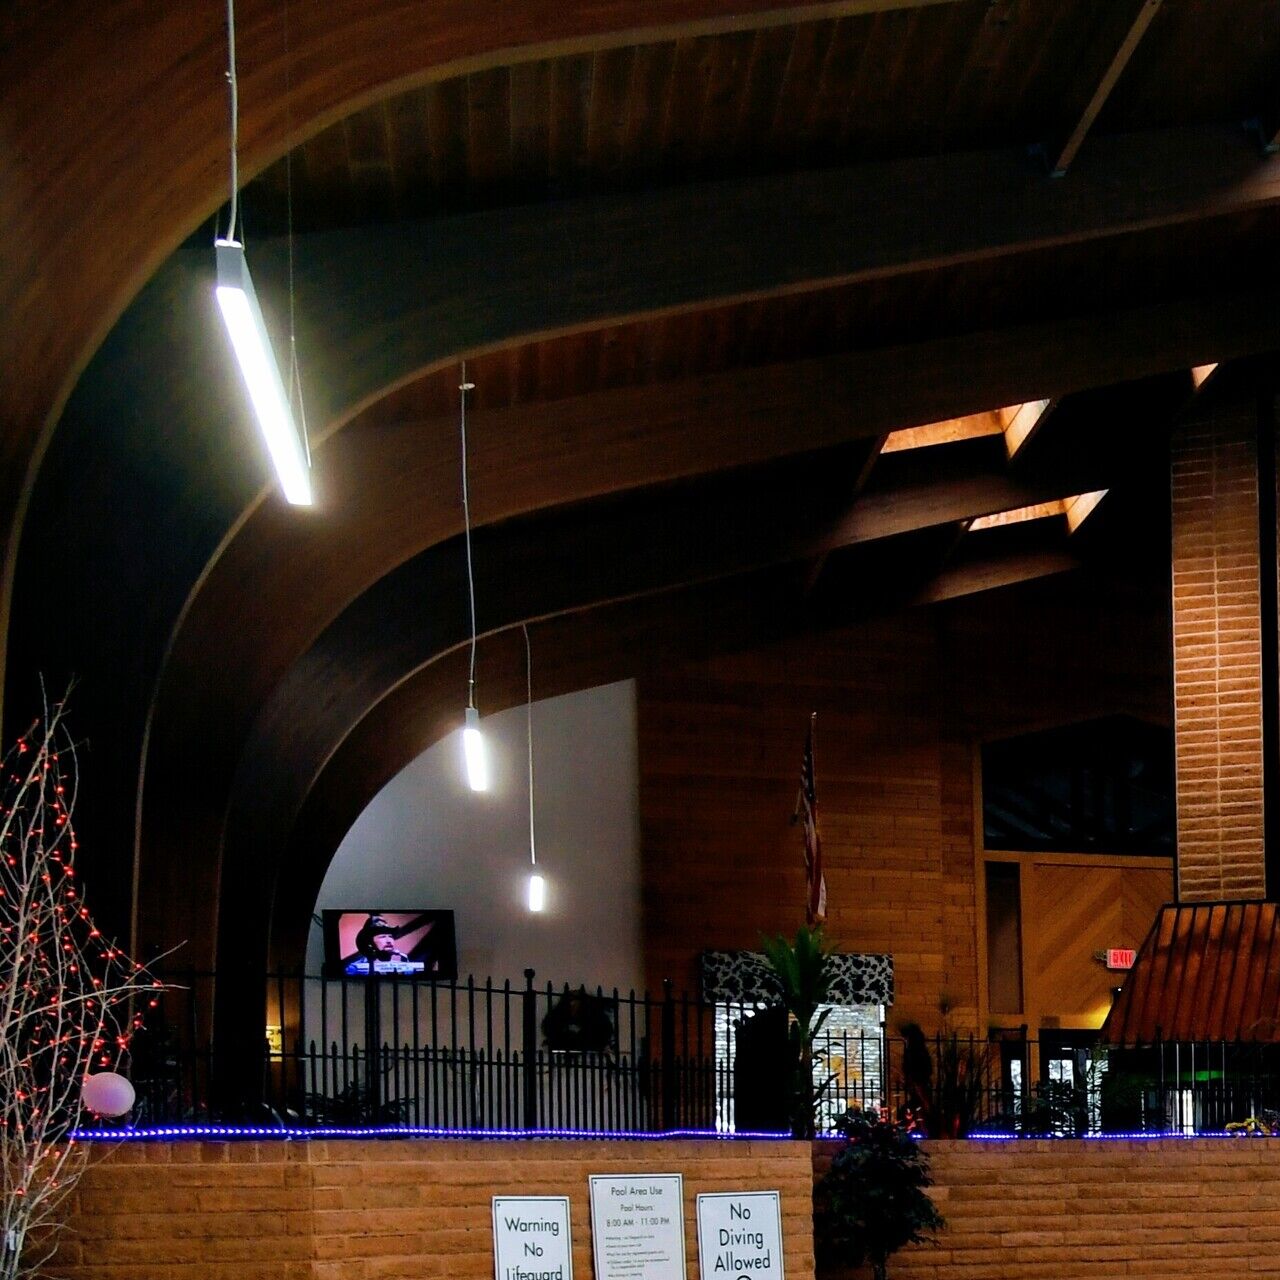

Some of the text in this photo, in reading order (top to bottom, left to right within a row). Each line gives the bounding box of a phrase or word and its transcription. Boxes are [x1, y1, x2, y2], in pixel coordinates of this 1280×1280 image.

[1112, 951, 1133, 965] EXIT
[611, 1186, 663, 1196] Pool Area Use
[620, 1204, 634, 1212] Pool
[730, 1203, 751, 1220] No
[505, 1217, 559, 1236] Warning
[660, 1217, 670, 1225] PM
[719, 1228, 763, 1249] Diving
[524, 1242, 543, 1257] No
[714, 1249, 770, 1272] Allowed
